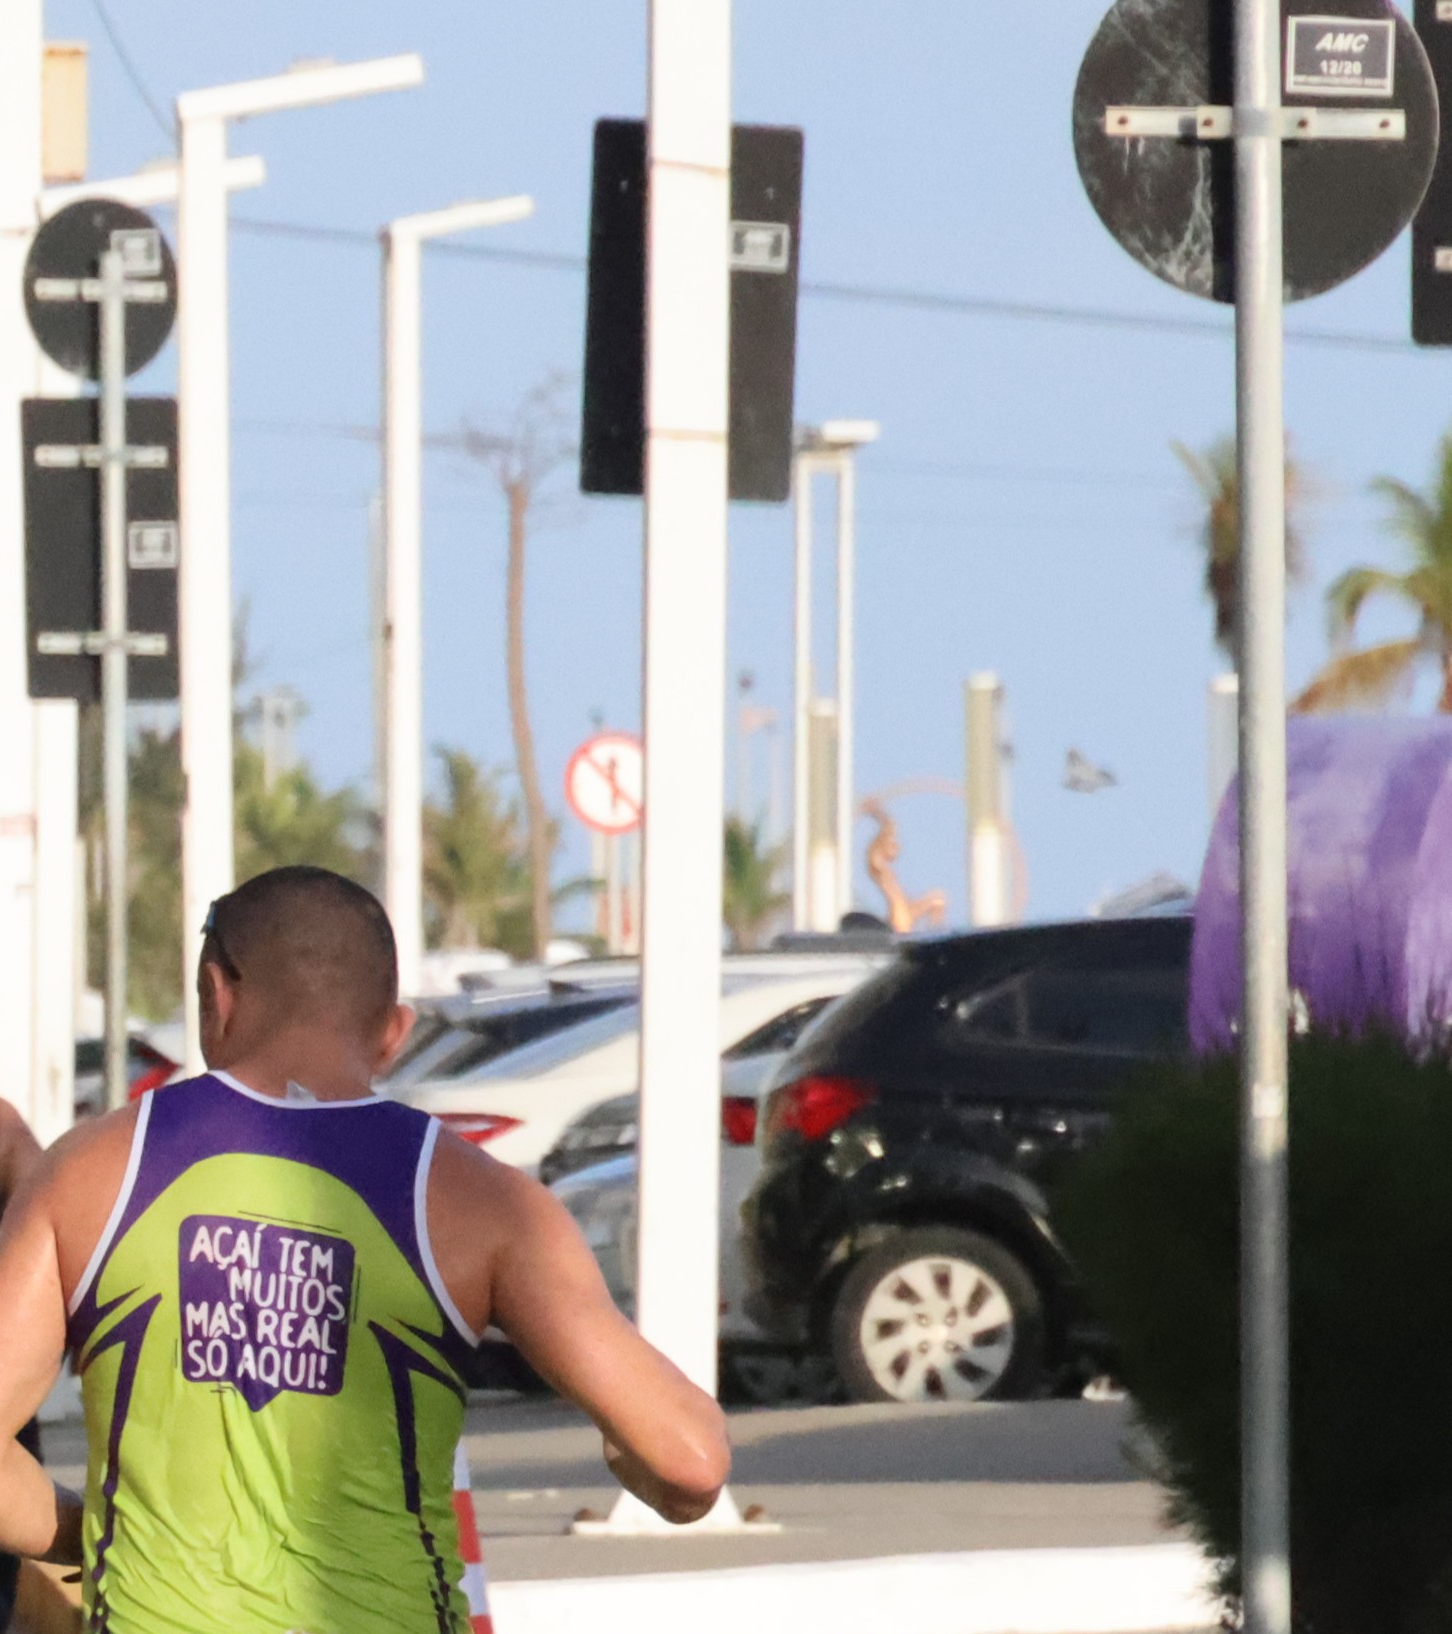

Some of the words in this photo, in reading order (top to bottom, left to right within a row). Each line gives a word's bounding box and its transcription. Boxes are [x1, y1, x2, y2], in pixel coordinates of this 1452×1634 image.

[1315, 32, 1369, 52] AMC
[190, 1223, 267, 1270] AÇAÍ
[279, 1237, 333, 1282] TEM
[185, 1301, 246, 1340] MAS
[256, 1309, 337, 1354] REAL
[187, 1329, 228, 1378] SÓ
[237, 1343, 327, 1390] AQUI!
